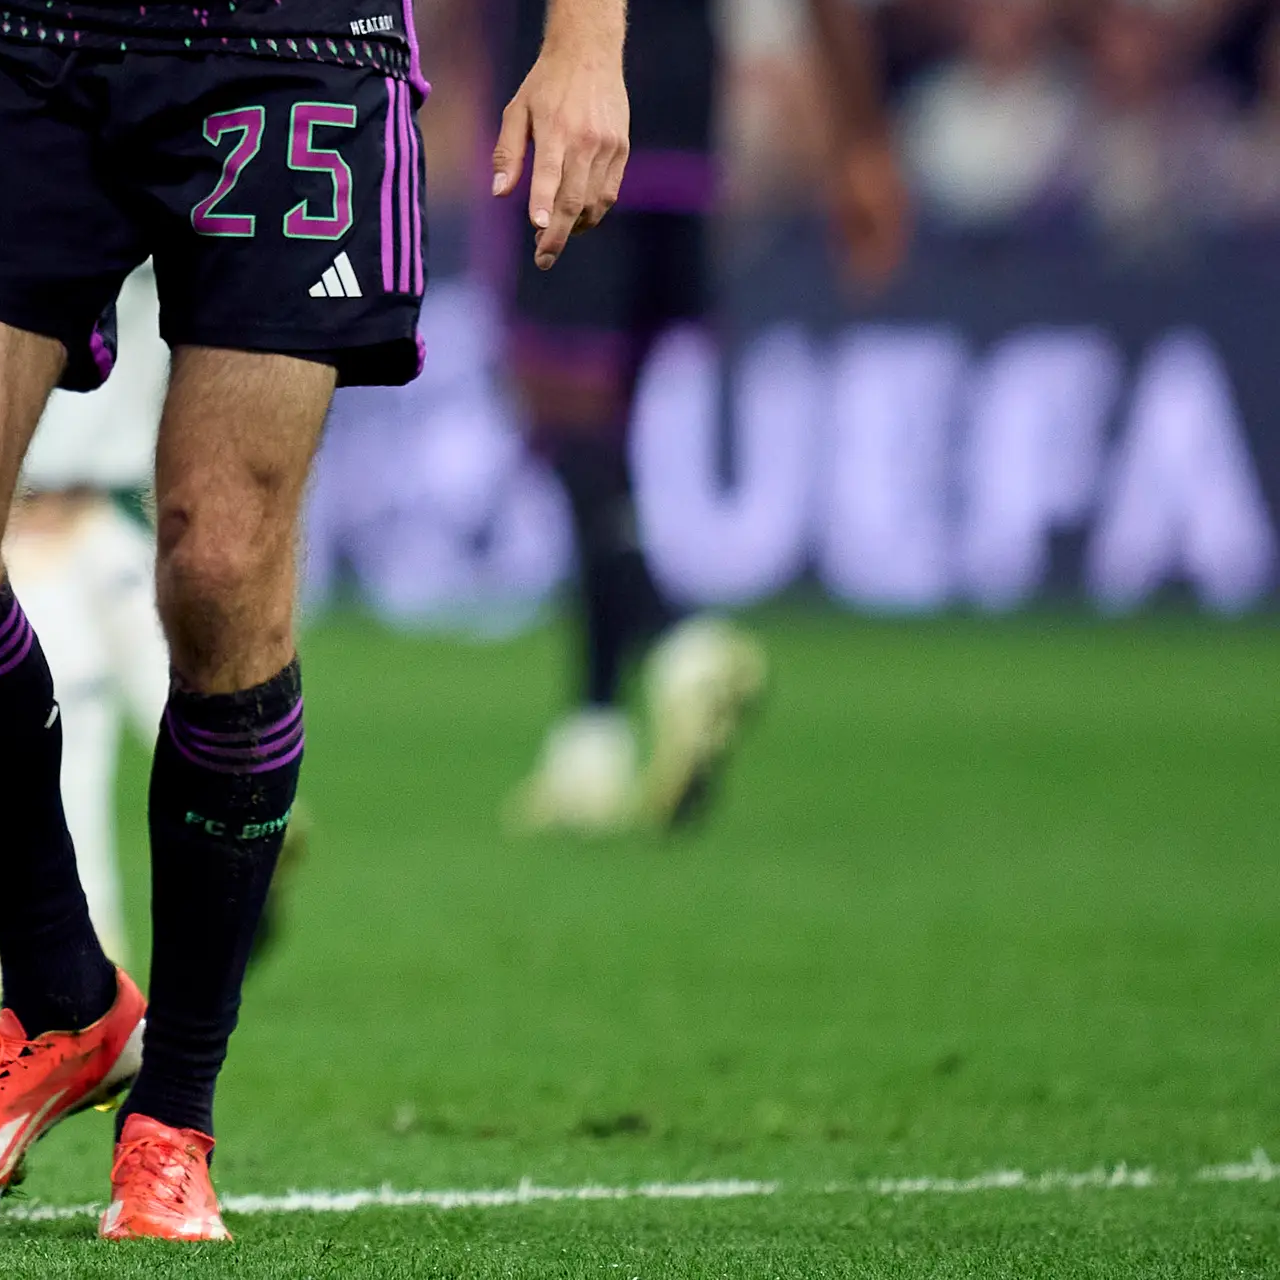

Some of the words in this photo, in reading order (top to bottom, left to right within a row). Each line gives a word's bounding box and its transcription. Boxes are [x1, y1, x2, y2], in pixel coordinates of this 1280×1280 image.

[192, 102, 358, 241] 25
[630, 325, 1272, 612] UEFA
[186, 811, 226, 836] FC
